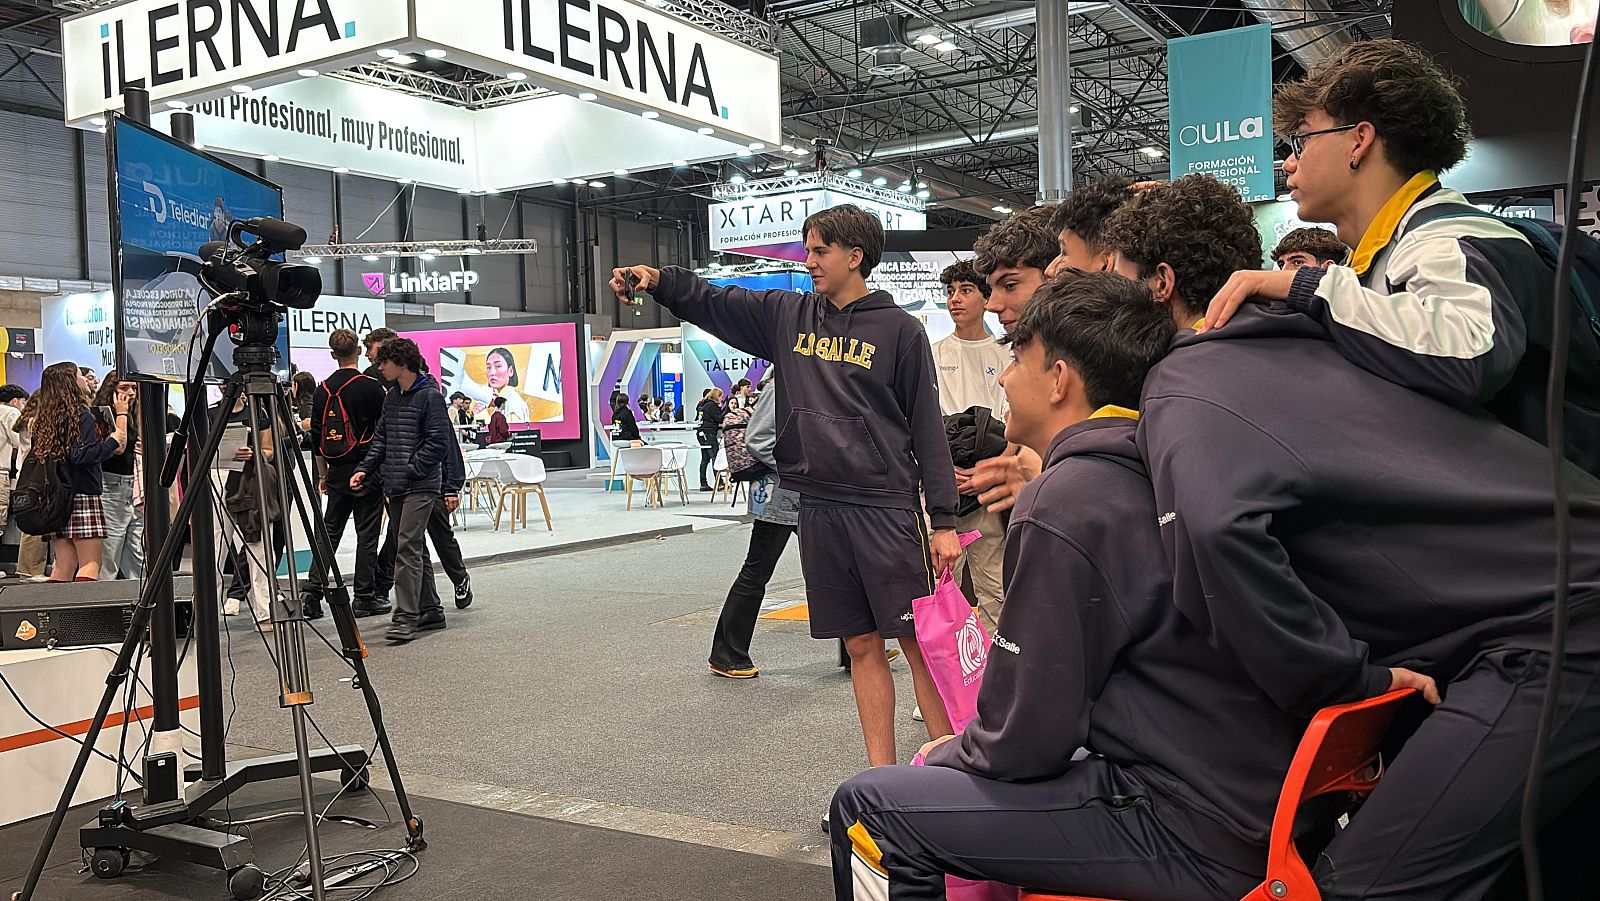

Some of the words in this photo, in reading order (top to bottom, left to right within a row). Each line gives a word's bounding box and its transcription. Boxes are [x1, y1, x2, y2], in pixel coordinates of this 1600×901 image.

[230, 94, 338, 143] Profesional,
[341, 116, 374, 150] muy
[379, 121, 465, 164] Profesional.
[1188, 155, 1254, 171] FORMACIÓN
[720, 198, 813, 228] XTART
[720, 232, 761, 244] FORMACIÓN
[899, 261, 939, 272] ESCUELA
[389, 270, 479, 293] LinkiaFP
[88, 329, 104, 347] muy
[998, 637, 1020, 655] Salle
